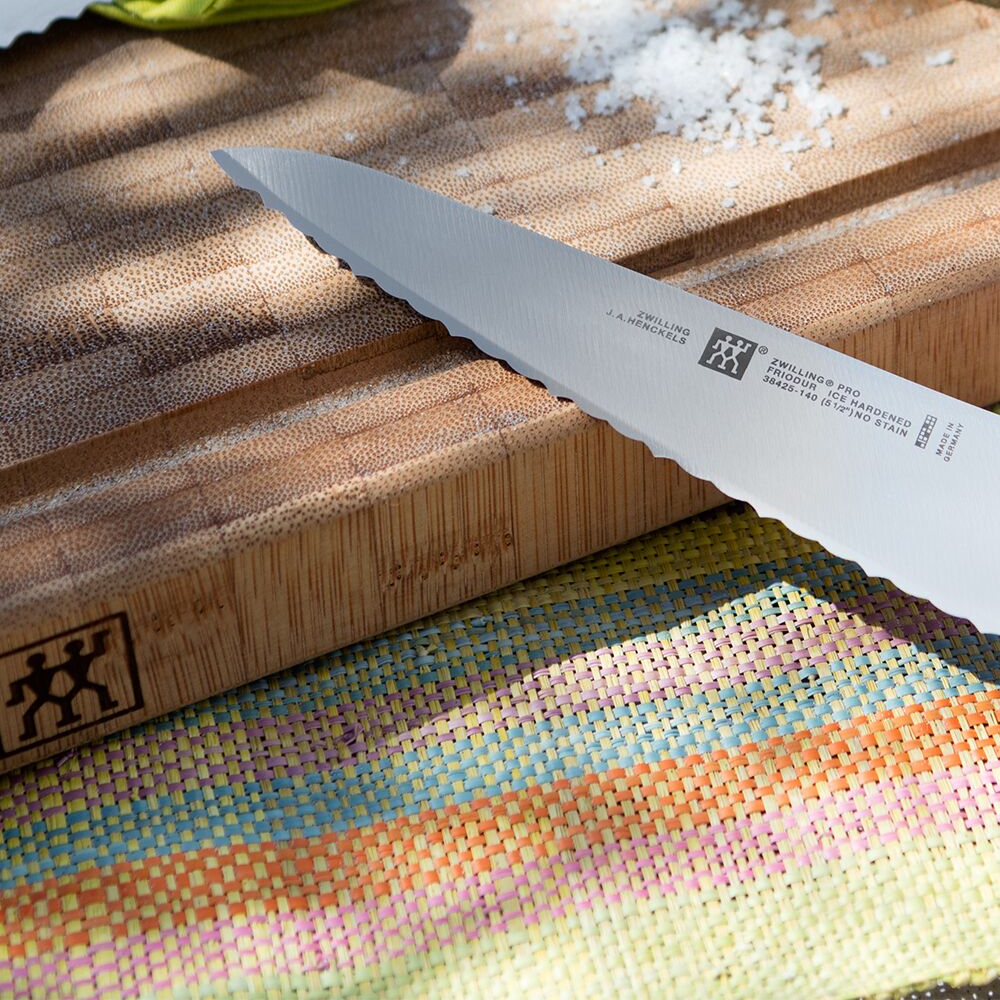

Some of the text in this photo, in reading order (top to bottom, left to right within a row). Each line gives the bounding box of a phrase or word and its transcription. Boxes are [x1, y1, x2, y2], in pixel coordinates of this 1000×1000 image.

[636, 310, 691, 337] ZWILLING
[762, 375, 818, 401] 38425-140
[874, 418, 909, 438] STAIN
[766, 366, 912, 428] FRIODUR ICE HARDENED
[836, 383, 861, 398] PRO
[935, 422, 954, 457] MADE IN
[943, 422, 964, 463] GERMANY
